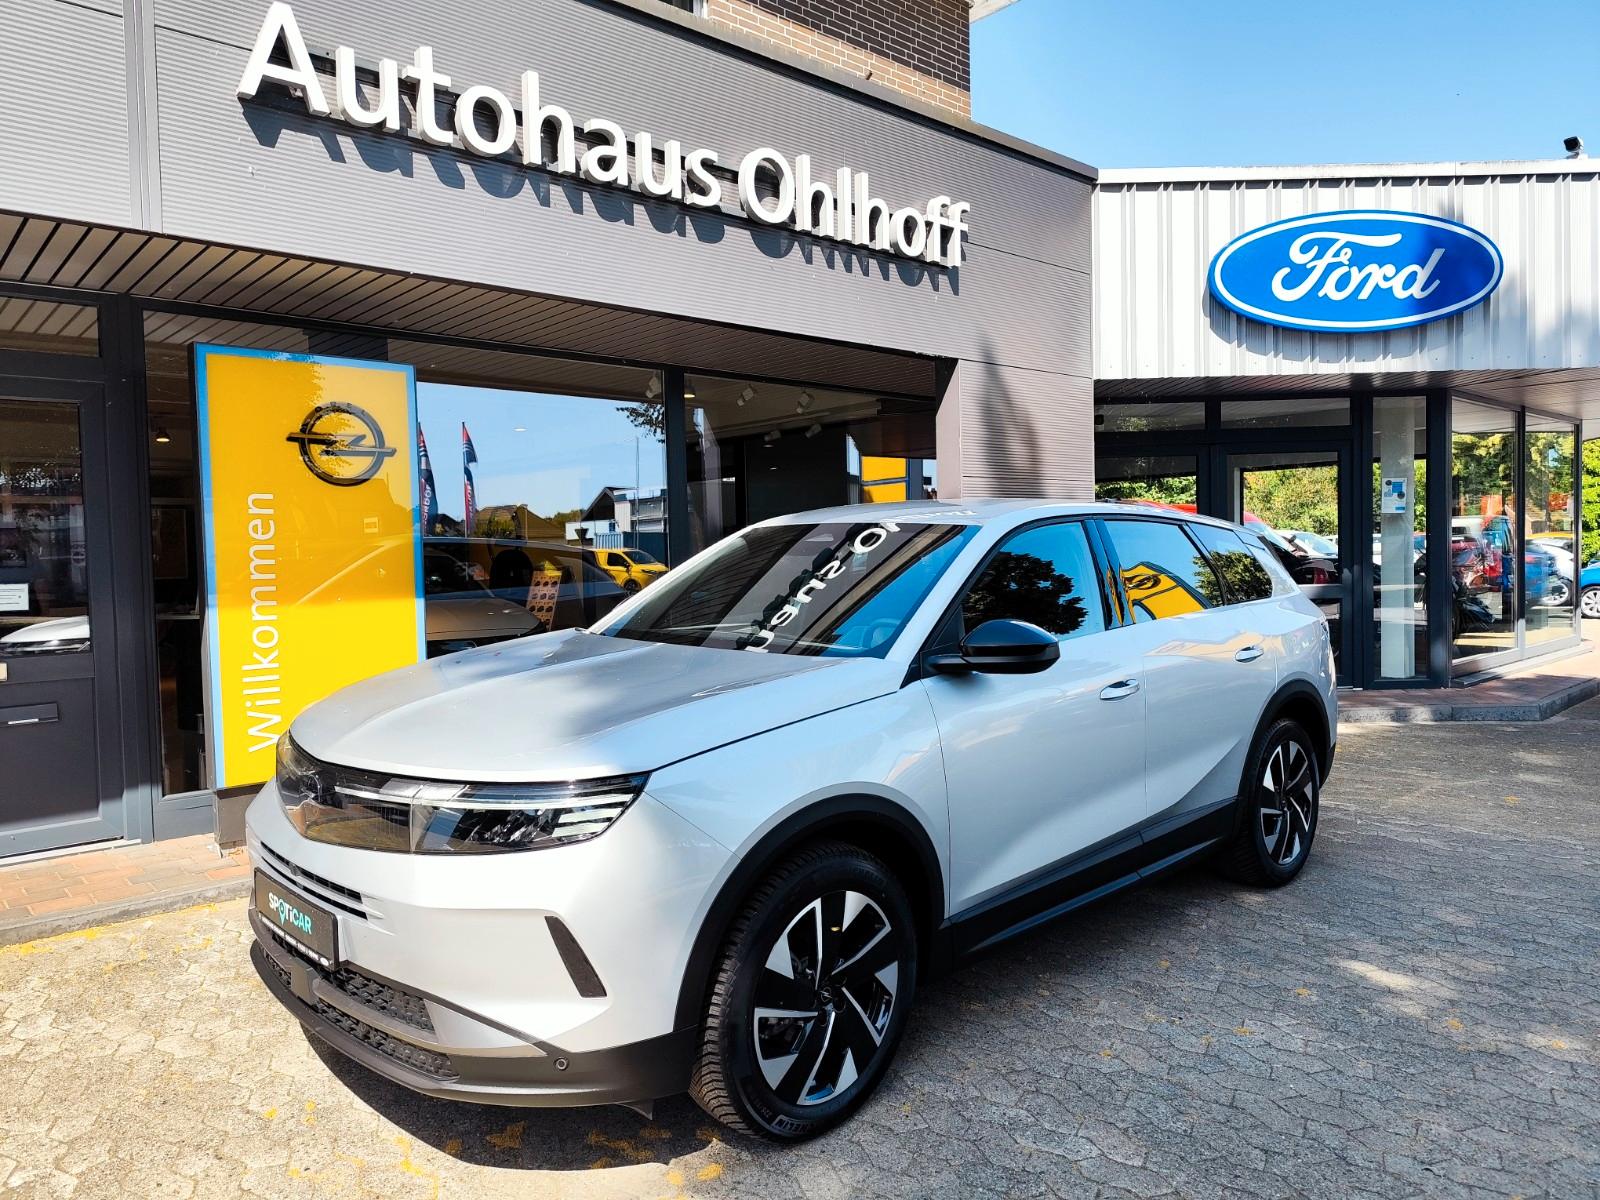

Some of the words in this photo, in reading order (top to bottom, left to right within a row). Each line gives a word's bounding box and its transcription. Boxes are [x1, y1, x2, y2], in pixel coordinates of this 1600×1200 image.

[236, 1, 722, 207] Autohaus
[738, 147, 970, 267] Ohlhoff
[1271, 231, 1446, 302] Ford
[241, 492, 282, 753] Willkommen
